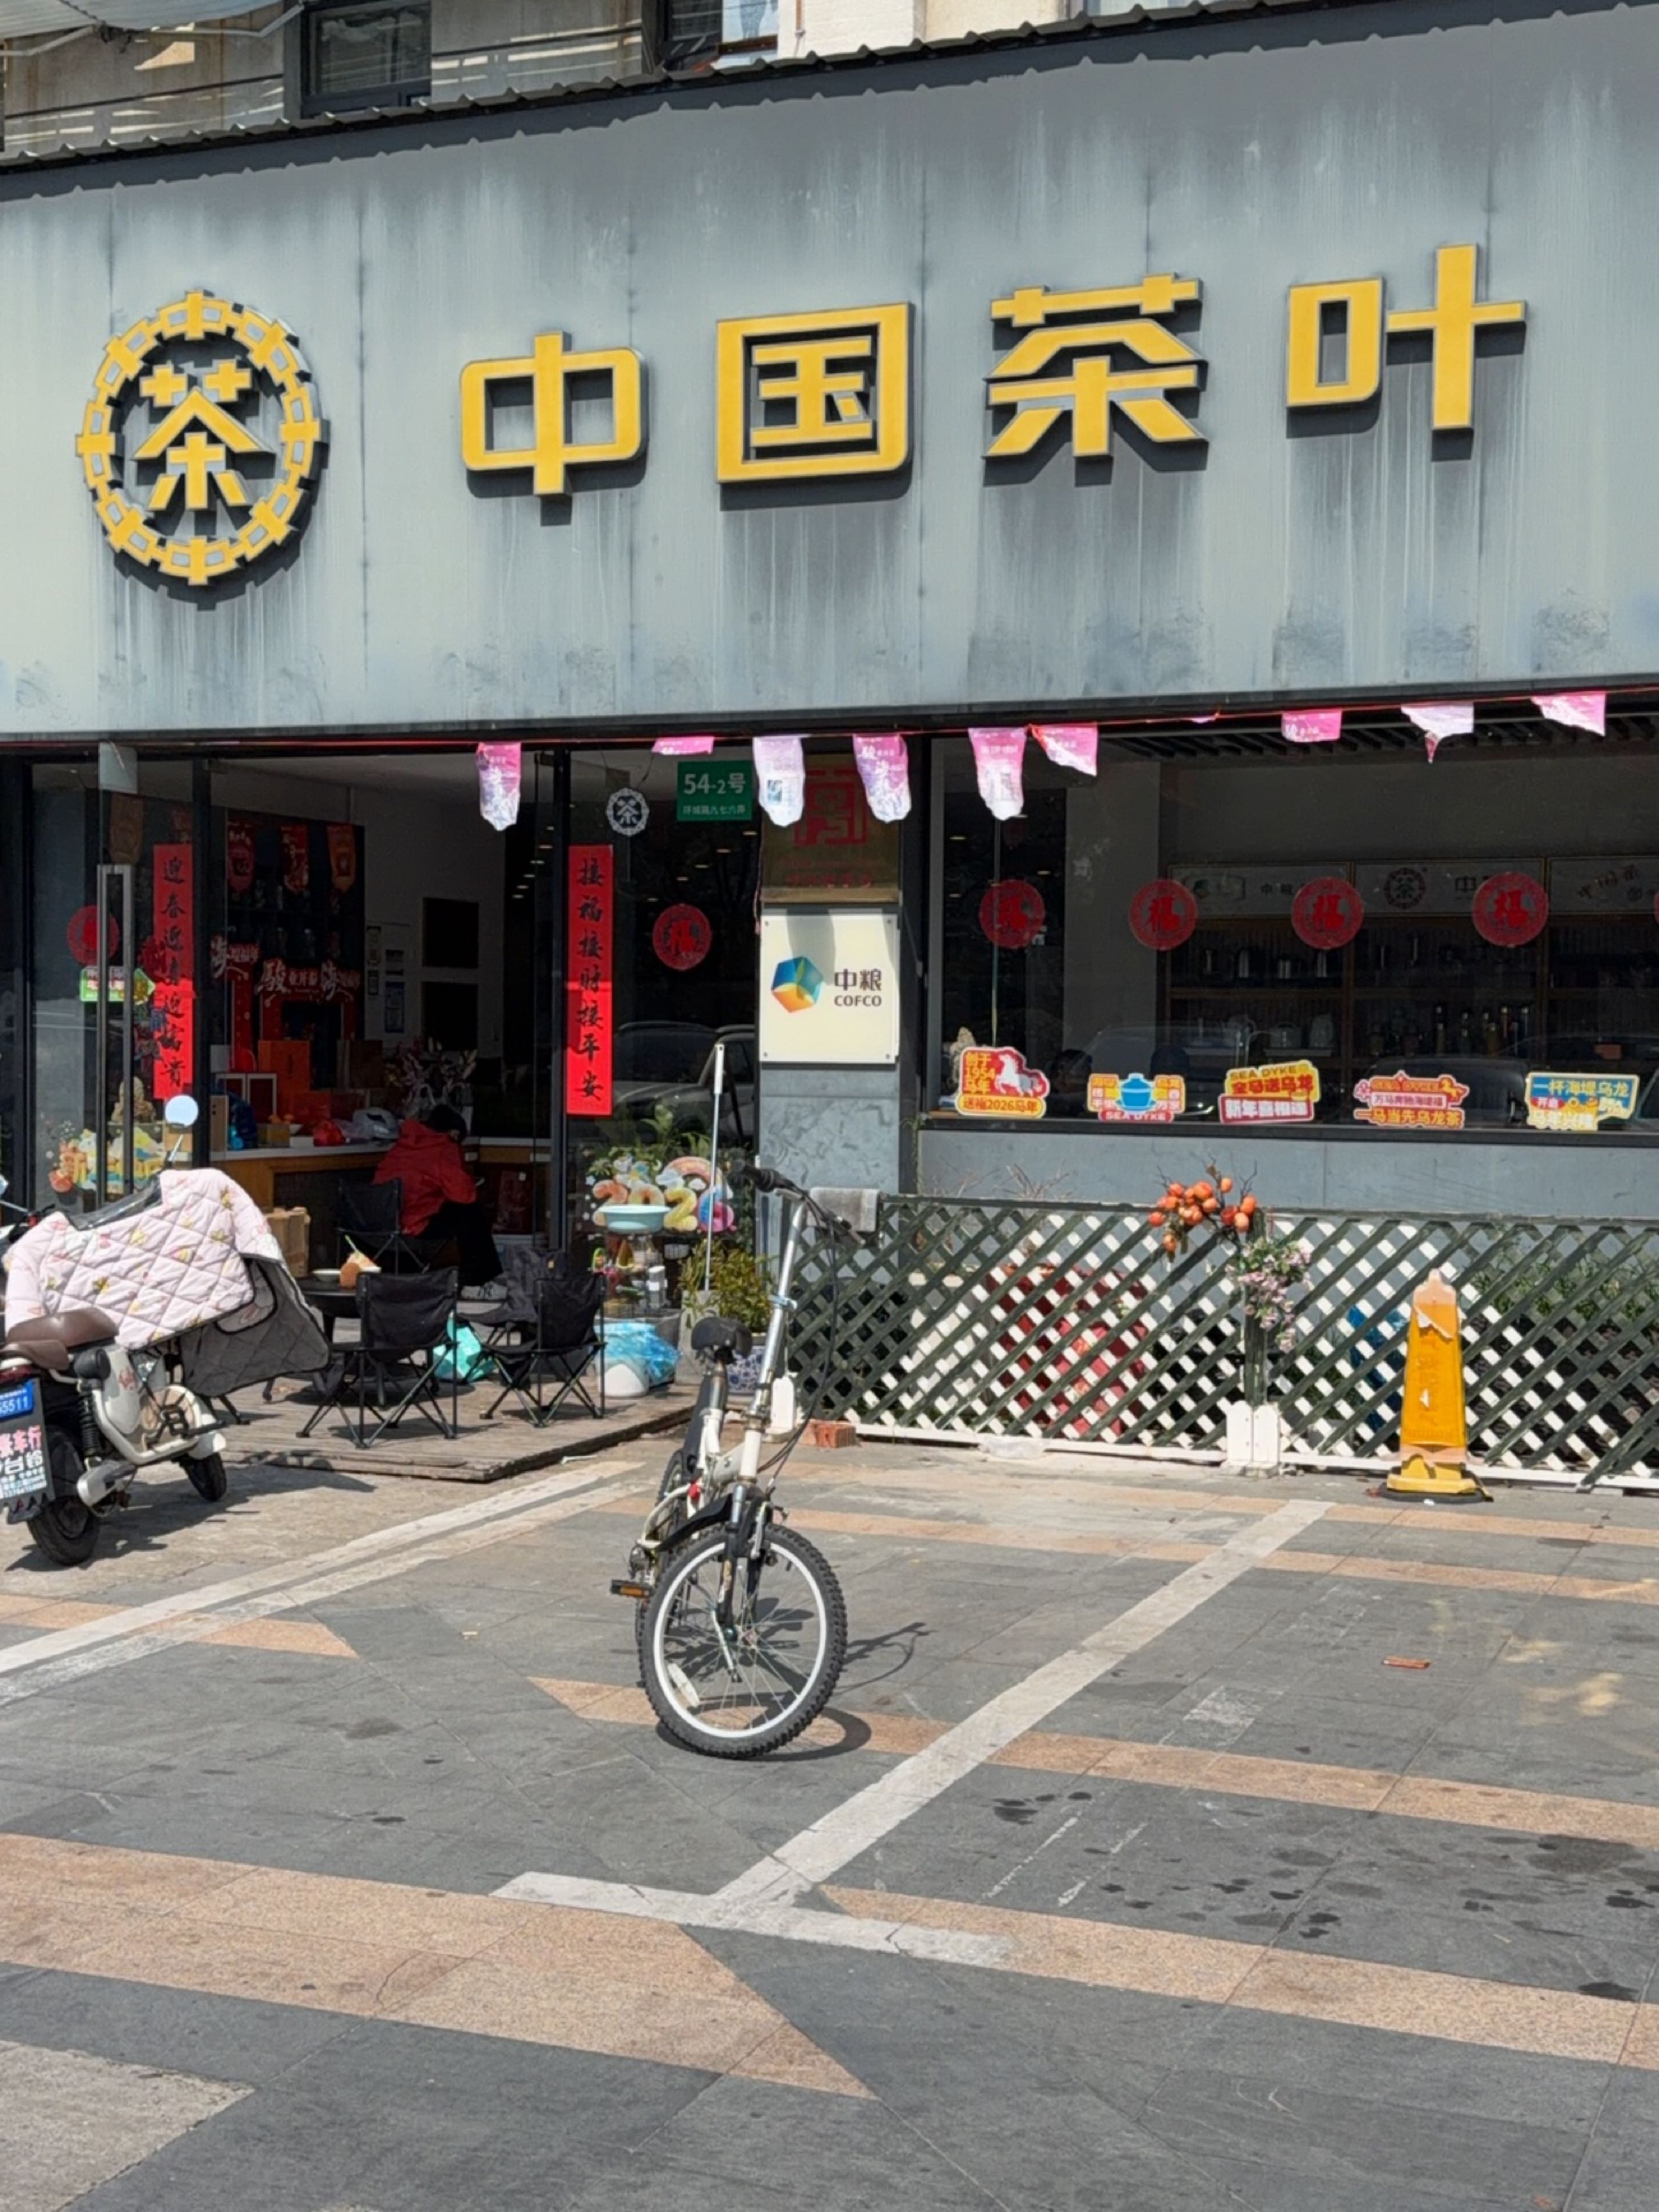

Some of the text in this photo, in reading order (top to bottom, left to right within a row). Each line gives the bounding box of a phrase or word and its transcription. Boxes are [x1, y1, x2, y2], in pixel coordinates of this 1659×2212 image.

[460, 243, 1526, 495] 中国茶叶
[683, 773, 746, 794] 54-2号
[834, 968, 882, 991] 中粮
[834, 995, 882, 1007] COFCO
[1230, 1065, 1297, 1080] SEA DYKE
